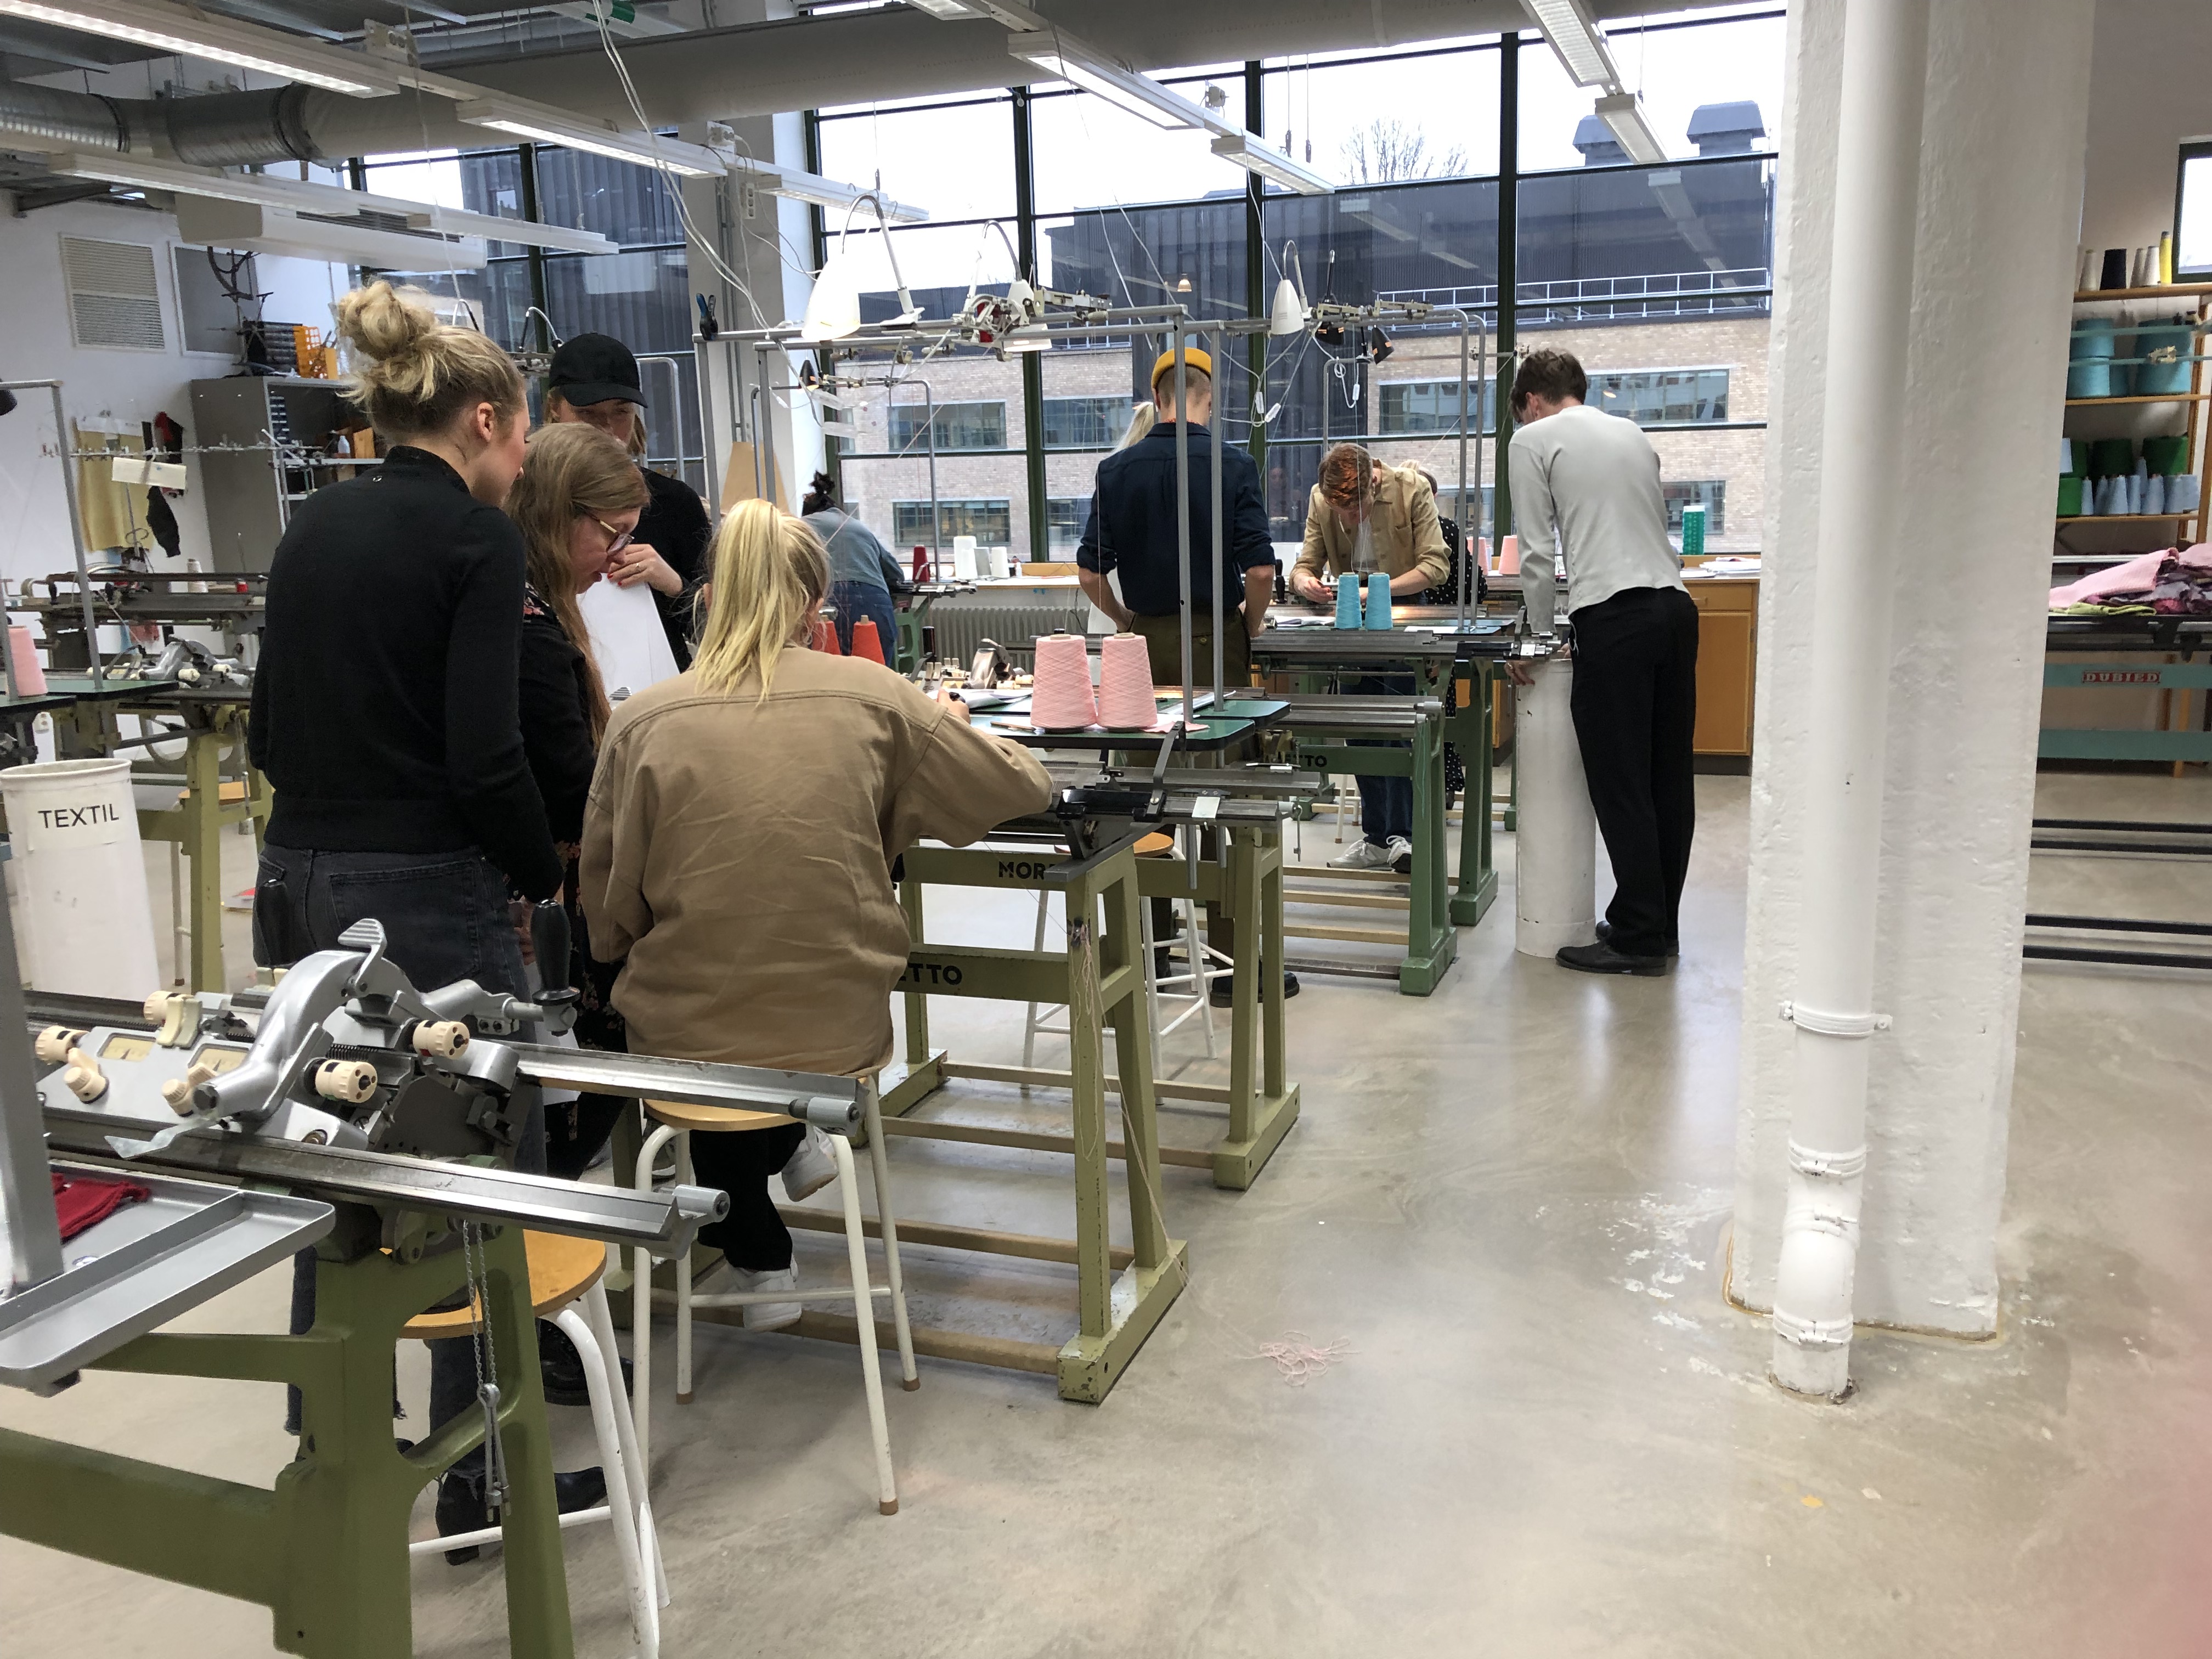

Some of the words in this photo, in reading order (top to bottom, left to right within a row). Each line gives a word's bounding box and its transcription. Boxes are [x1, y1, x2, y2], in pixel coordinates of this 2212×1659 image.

[2086, 673, 2157, 682] DUBIED
[38, 804, 119, 828] TEXTIL
[998, 861, 1056, 879] MOR
[899, 962, 962, 985] TTO
